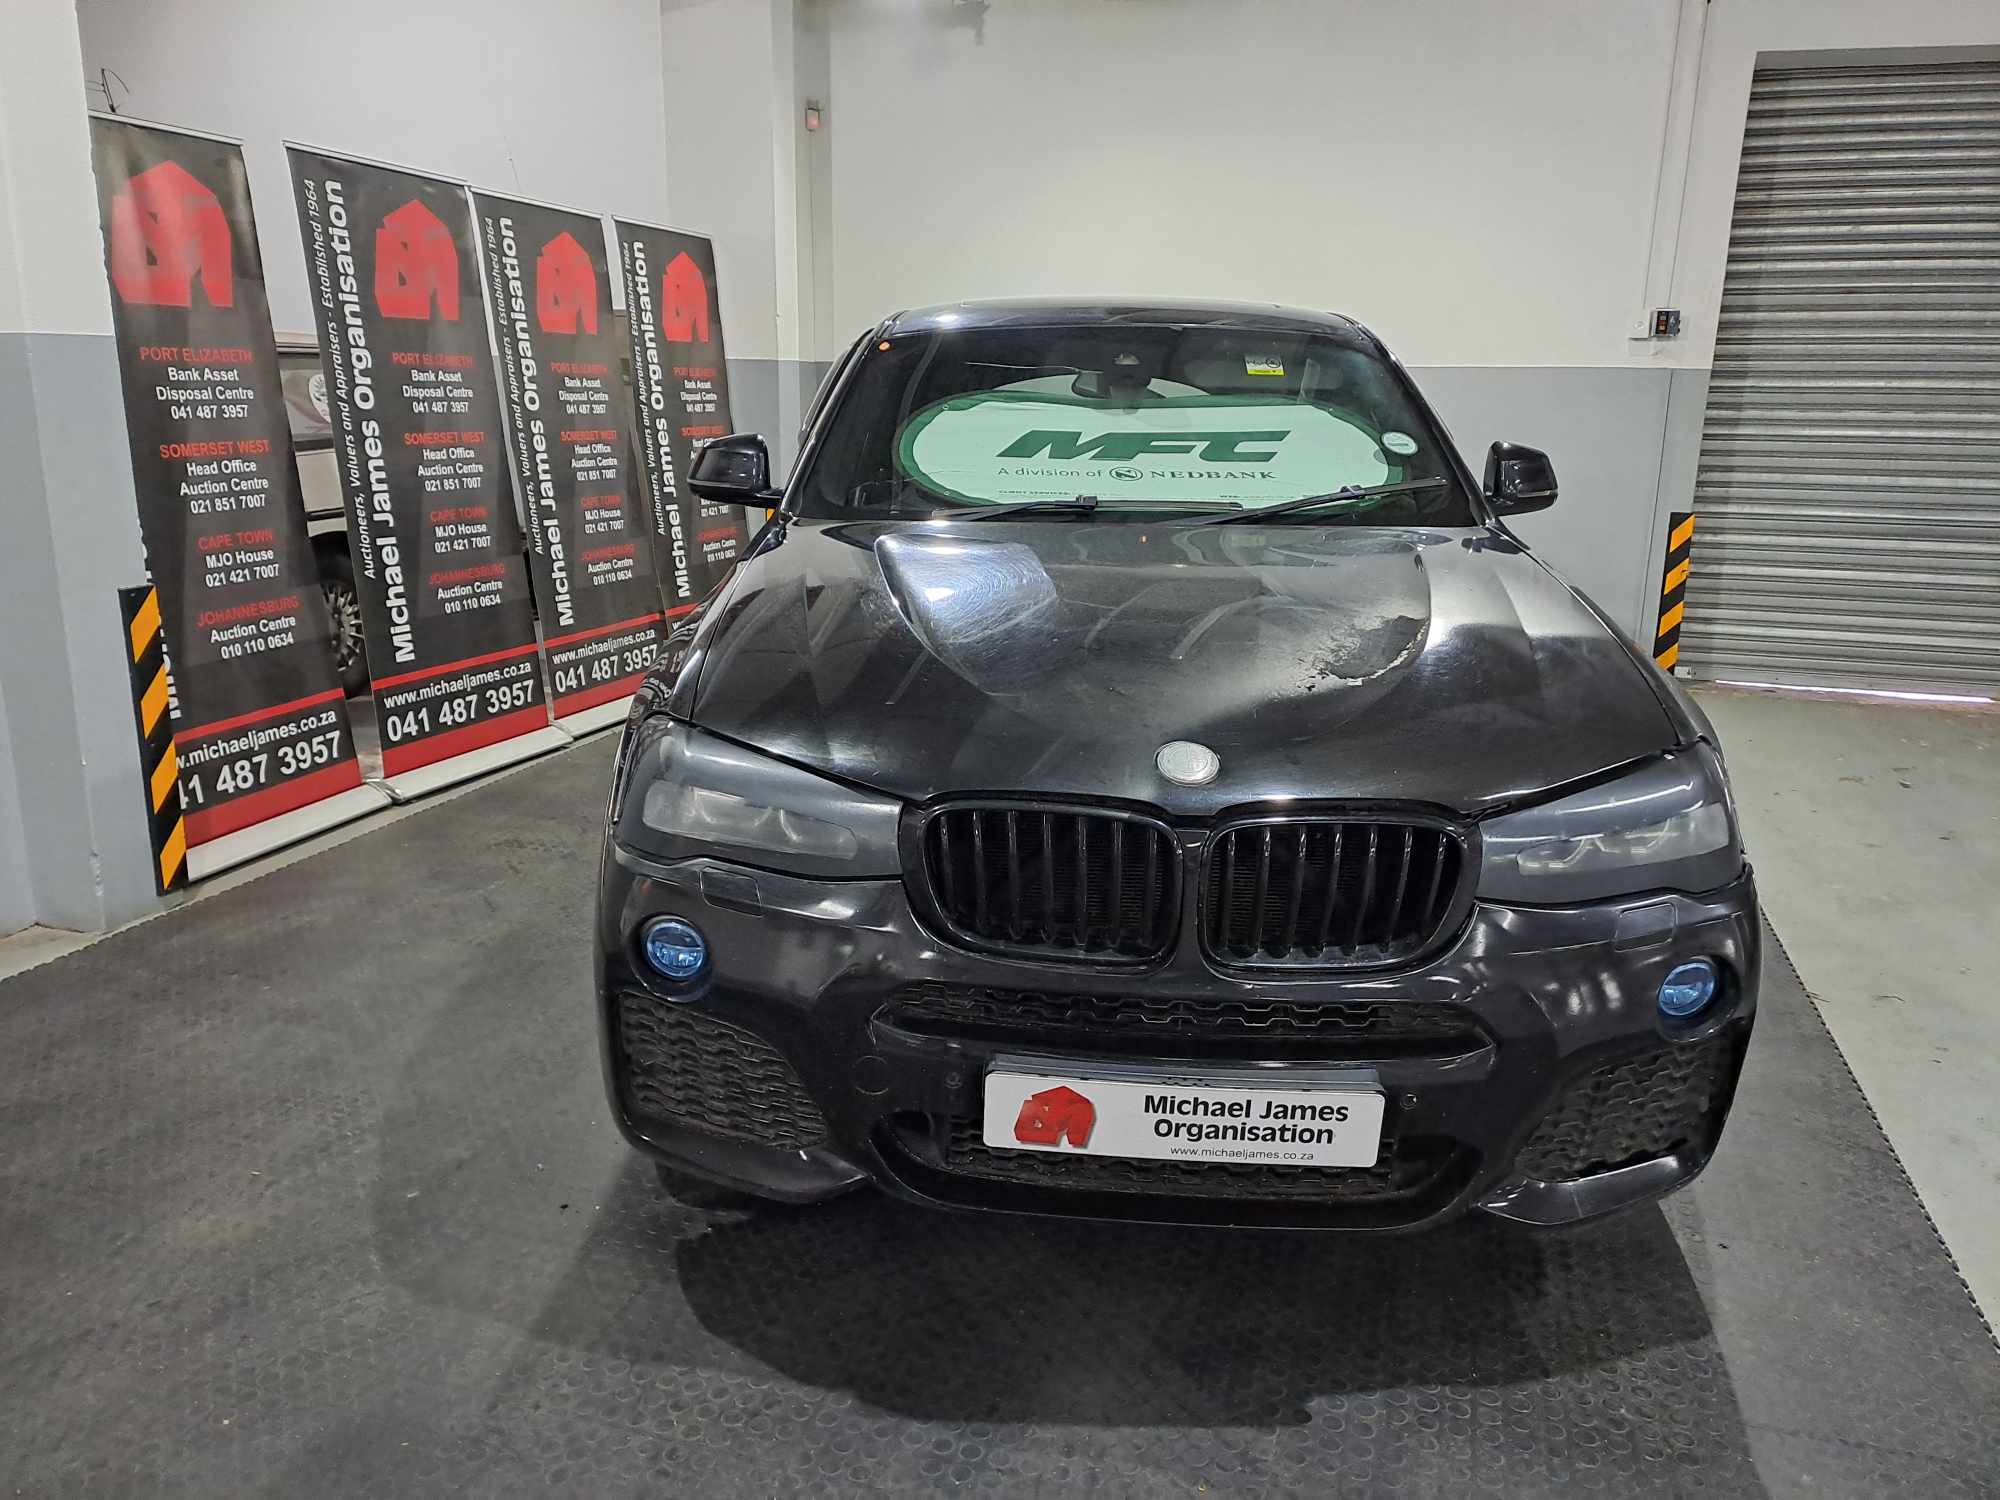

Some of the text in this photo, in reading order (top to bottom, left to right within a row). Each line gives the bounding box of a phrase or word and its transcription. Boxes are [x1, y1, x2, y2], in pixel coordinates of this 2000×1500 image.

[303, 178, 320, 219] 1964
[308, 220, 335, 309] Established
[139, 347, 254, 362] PORT ELIZABETH
[328, 321, 348, 399] Appraisers
[167, 367, 239, 381] Bank Asset
[411, 370, 462, 382] Bank Asset
[155, 386, 254, 403] Disposal Centre
[402, 386, 474, 399] Disposal Centre
[171, 404, 248, 420] 041 487 3957
[337, 402, 352, 431] and
[412, 402, 429, 413] 041
[431, 401, 448, 412] 487
[512, 404, 524, 429] and
[640, 404, 650, 427] and
[324, 179, 416, 663] Michael James Organisation
[500, 217, 575, 627] Michael James Organisation
[632, 241, 691, 598] Michael James Organisation
[159, 439, 270, 458] SOMERSET WEST
[422, 447, 475, 461] Head Office
[518, 431, 532, 477] Valuers
[996, 430, 1291, 462] MFC
[186, 459, 257, 477] Head Office
[347, 434, 361, 487] Valuers
[417, 463, 484, 477] Auction Centre
[998, 467, 1277, 479] A division of NEDBANK
[180, 477, 269, 496] Auction Centre
[425, 479, 441, 492] 021
[443, 478, 460, 490] 851
[190, 493, 266, 514] 021 851 7007
[197, 529, 273, 550] CAPE TOWN
[354, 493, 376, 579] Auctioneers,
[435, 523, 487, 538] MJO House
[434, 536, 492, 553] 021 421 7007
[205, 549, 274, 569] MJO House
[587, 562, 612, 574] Auction
[205, 564, 280, 588] 021 421 7007
[437, 580, 504, 600] Auction Centre
[197, 596, 299, 627] JOHANNESBURG
[444, 594, 502, 614] 010 110 0634
[210, 615, 296, 643] Auction Centre
[220, 632, 294, 660] 010 110 0634
[551, 629, 656, 665] www.michaeljames.co.za
[554, 644, 658, 693] 041 487 3957
[383, 662, 532, 709] www.michaeljames.co.za
[386, 679, 535, 742] 041 487 3957
[216, 753, 268, 794] 487
[277, 730, 342, 776] 3957
[1143, 1094, 1350, 1122] Michael James
[1153, 1119, 1335, 1145] Organisation
[1170, 1145, 1315, 1162] www.michaeljames.co.za
